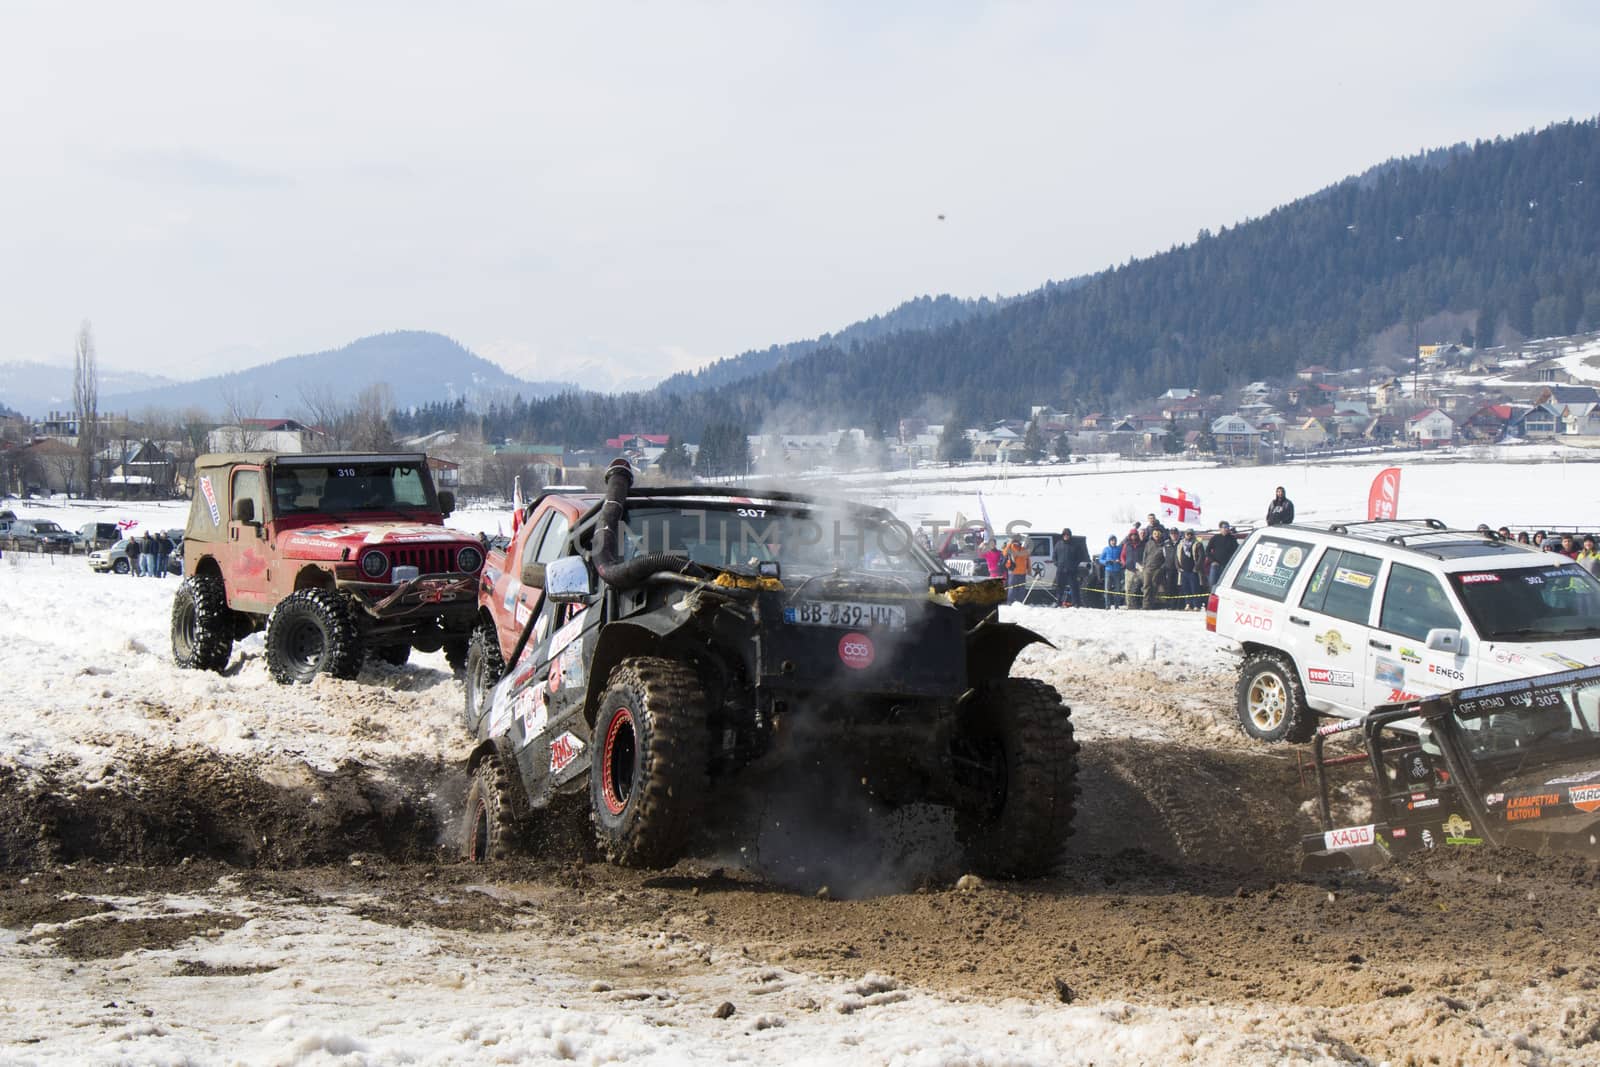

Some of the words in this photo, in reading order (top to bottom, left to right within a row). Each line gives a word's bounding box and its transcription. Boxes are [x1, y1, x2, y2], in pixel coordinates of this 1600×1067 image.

[337, 468, 355, 477] 310
[736, 508, 766, 518] 307
[1255, 553, 1275, 568] 305
[1462, 574, 1499, 583] MOTUL
[1435, 666, 1465, 682] ENEOS
[1459, 702, 1477, 714] OFF
[1479, 697, 1505, 711] ROAD
[1537, 694, 1560, 707] 305
